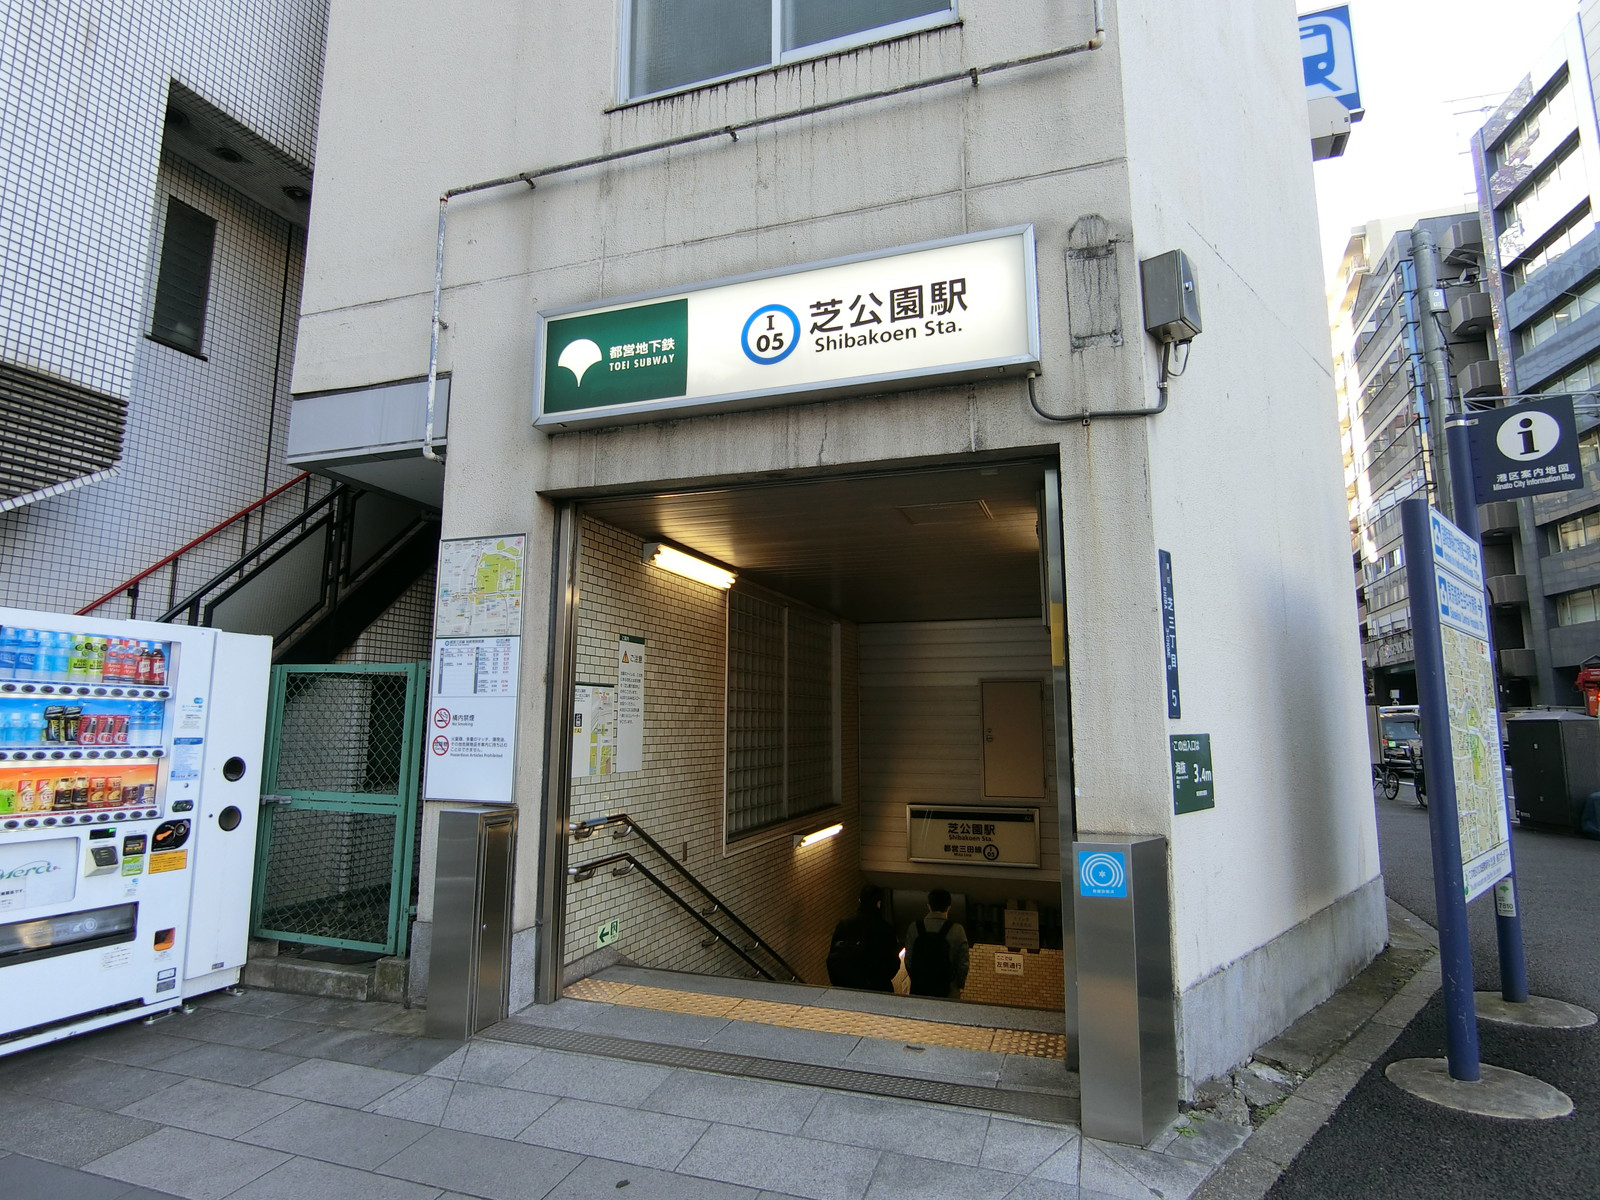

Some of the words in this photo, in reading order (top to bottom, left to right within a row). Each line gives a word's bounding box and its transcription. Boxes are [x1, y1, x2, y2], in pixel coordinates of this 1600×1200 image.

[809, 277, 968, 335] 芝公園駅
[766, 315, 775, 331] I
[756, 332, 784, 353] 05
[815, 326, 917, 353] Shibakoen
[924, 320, 963, 336] Sta.
[609, 337, 676, 359] 都営地下鉄
[609, 360, 630, 371] TOEI
[634, 354, 675, 368] SUBWAY
[1492, 482, 1513, 491] Minato
[1513, 480, 1526, 489] City
[1526, 474, 1561, 486] Information
[1561, 472, 1576, 482] Map
[1496, 463, 1570, 483] 港区案内地図
[452, 714, 475, 722] 構内禁煙
[1193, 763, 1212, 783] 3.4m
[947, 822, 996, 836] 芝公園駅
[948, 834, 981, 842] Shibakoen
[944, 844, 983, 854] 都営三田線
[1498, 902, 1514, 910] 7810
[996, 961, 1022, 970] 左側通行
